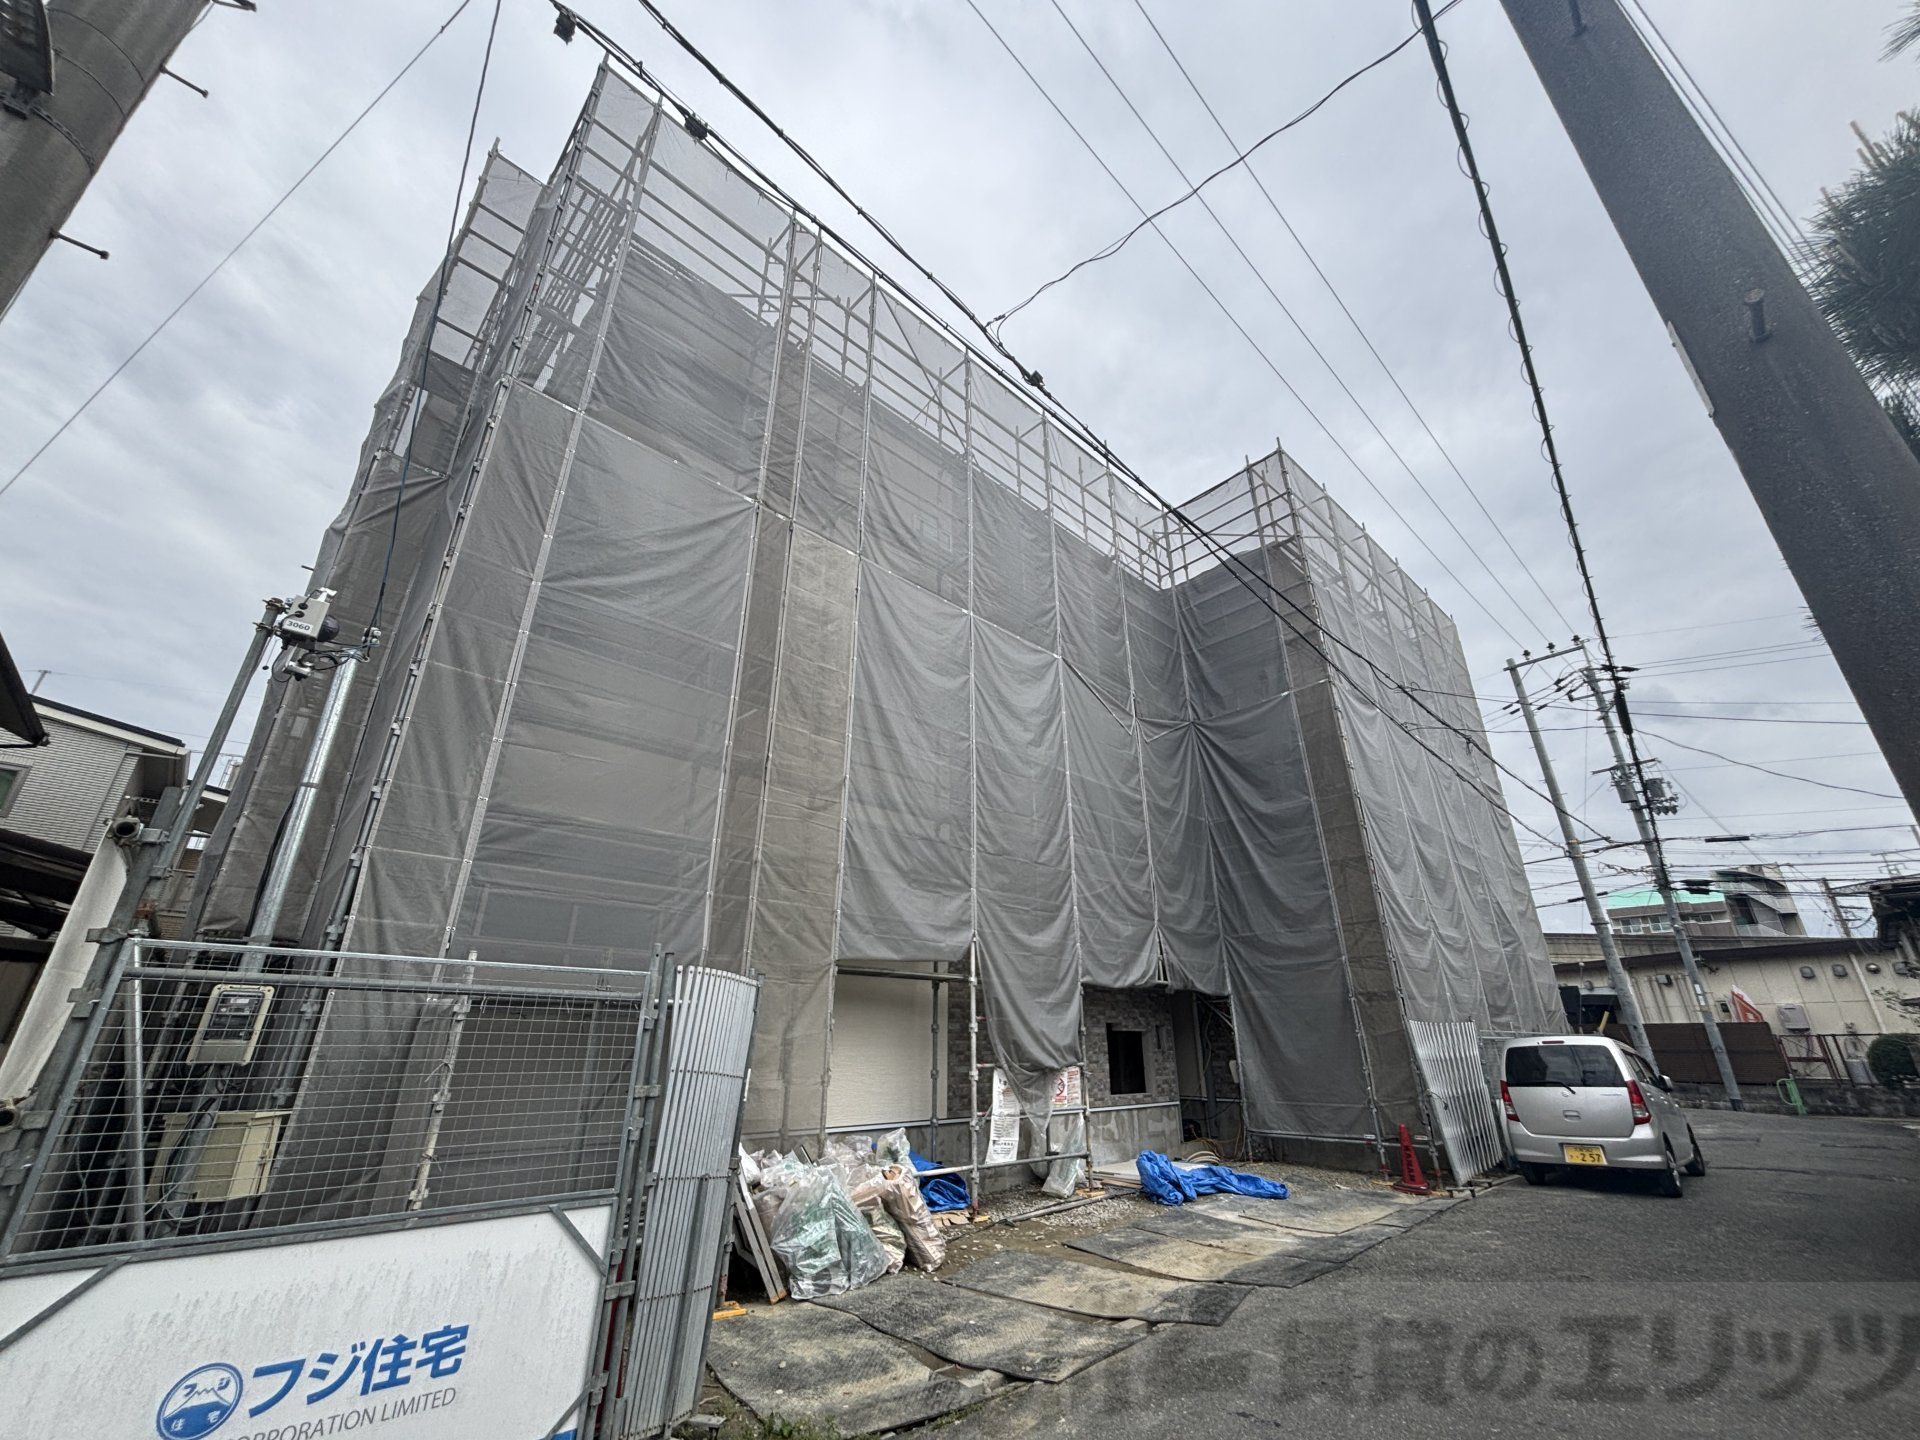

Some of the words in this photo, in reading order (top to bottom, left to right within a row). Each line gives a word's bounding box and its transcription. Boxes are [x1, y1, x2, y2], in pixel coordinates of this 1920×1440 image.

[286, 620, 311, 631] 3060
[248, 1324, 470, 1419] フジ住宅
[229, 1405, 377, 1440] PORATION
[380, 1387, 457, 1422] LIMITED
